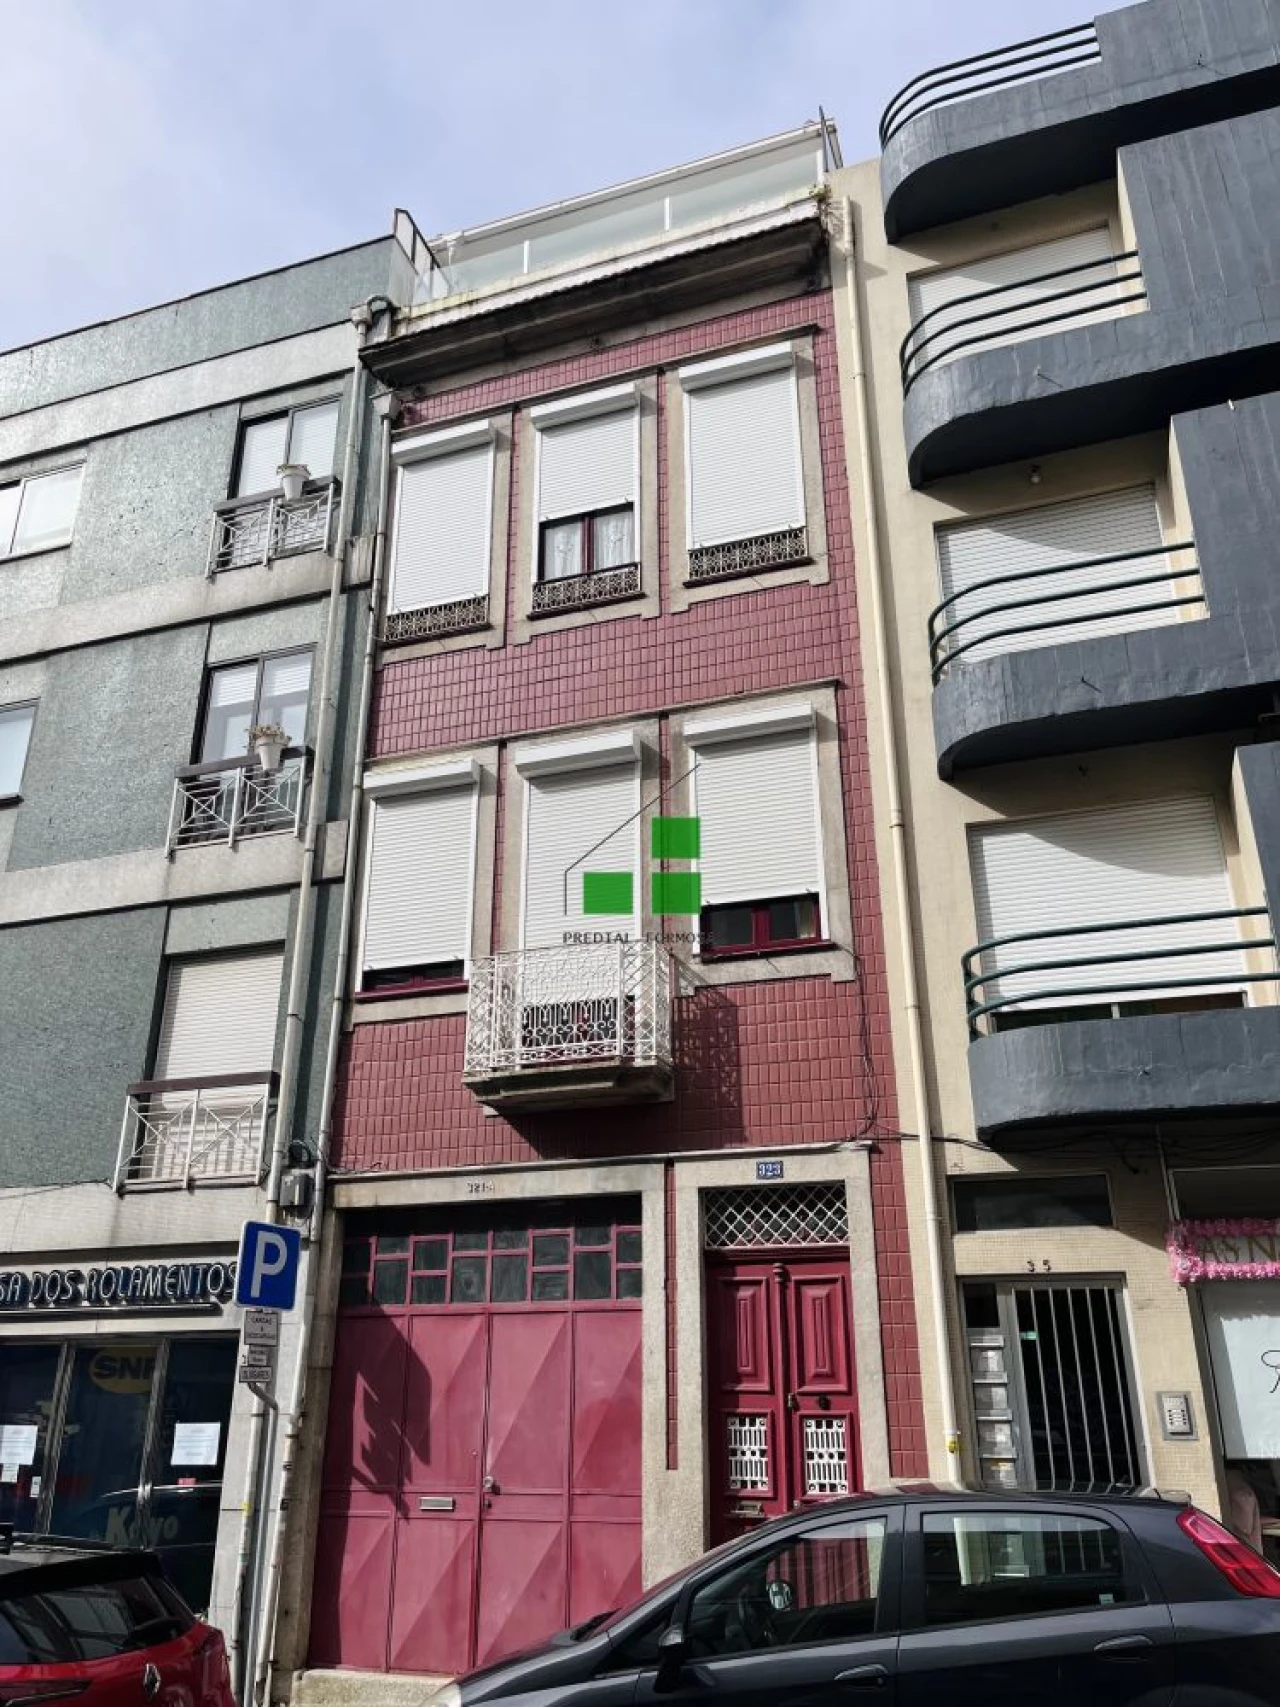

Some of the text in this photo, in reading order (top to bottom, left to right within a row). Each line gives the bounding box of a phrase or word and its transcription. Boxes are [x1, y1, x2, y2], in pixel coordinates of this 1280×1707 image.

[759, 1163, 781, 1177] 323
[29, 1269, 76, 1302] DOS
[84, 1262, 235, 1302] ROLAMENTOS
[250, 1230, 288, 1298] P
